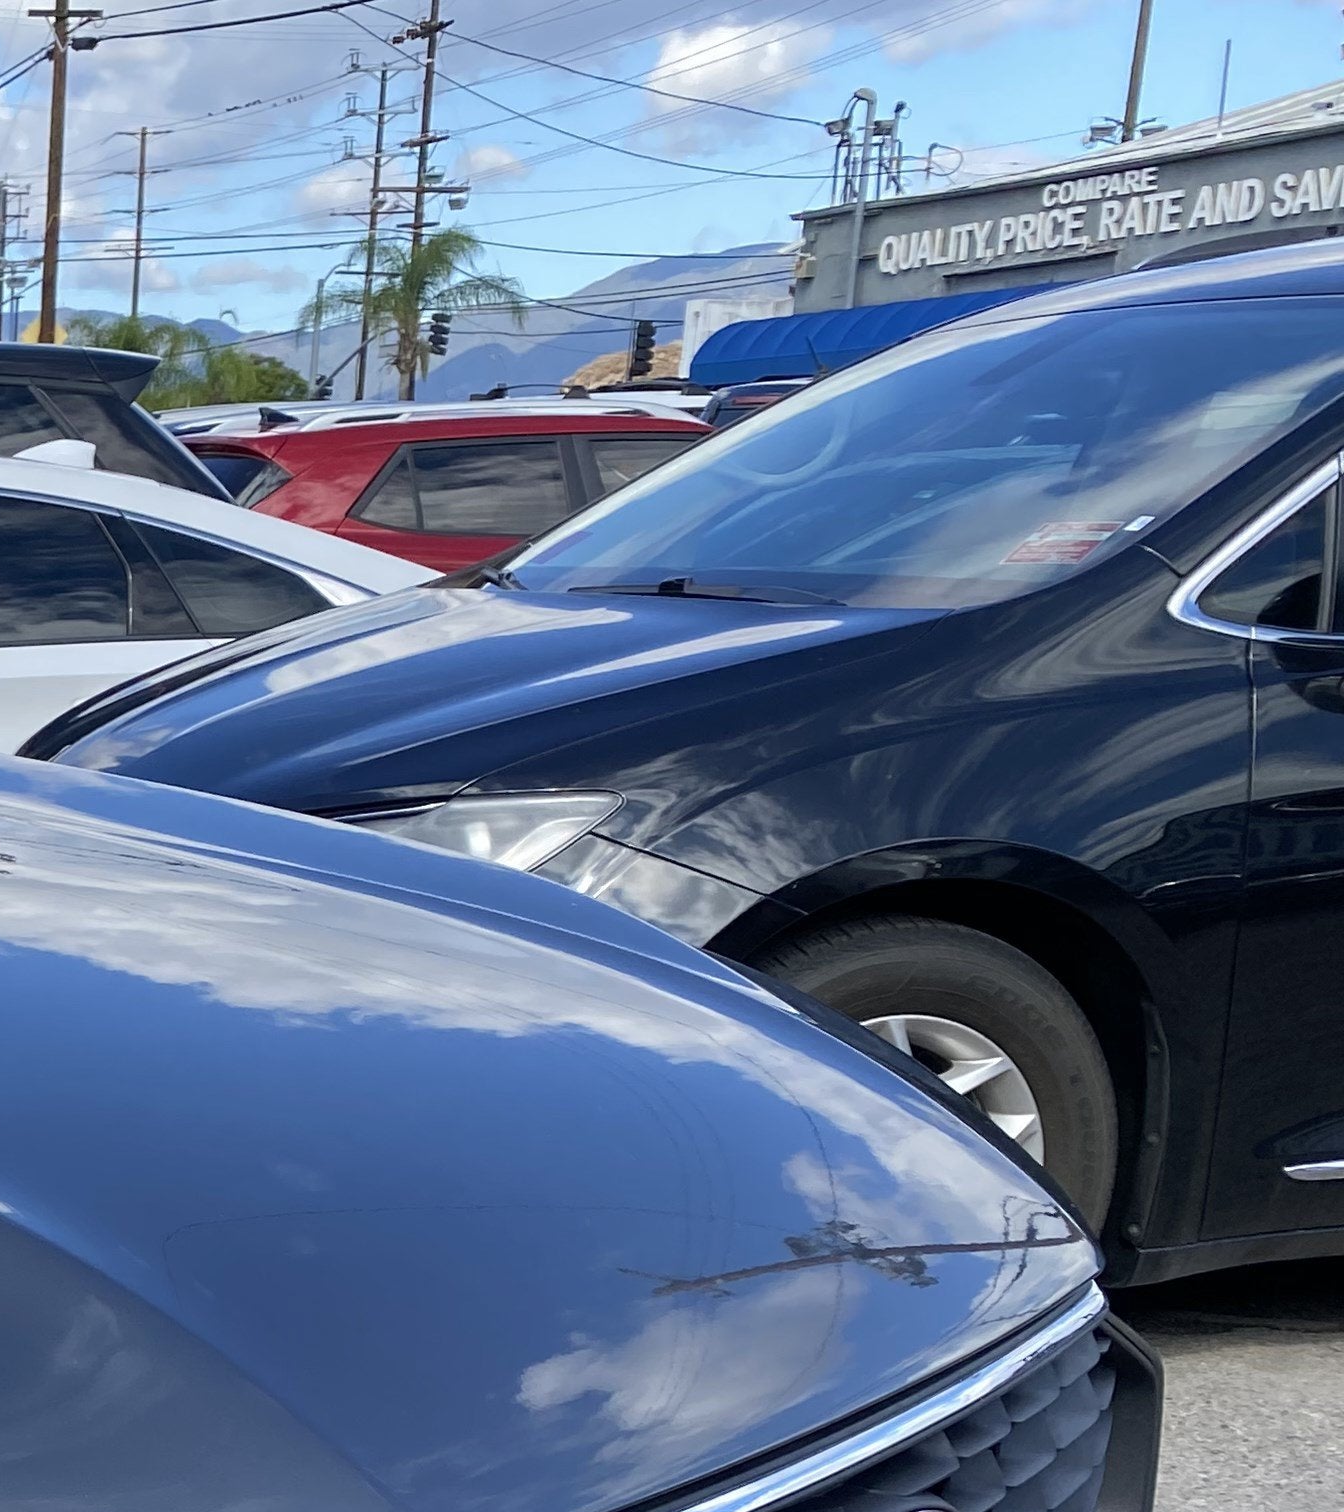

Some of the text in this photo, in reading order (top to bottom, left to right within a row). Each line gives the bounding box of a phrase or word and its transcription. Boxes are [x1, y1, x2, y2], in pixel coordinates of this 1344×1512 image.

[1043, 168, 1159, 207] COMPARE
[1098, 189, 1184, 241] RATE
[1188, 178, 1265, 229] AND
[1270, 164, 1344, 218] SAV
